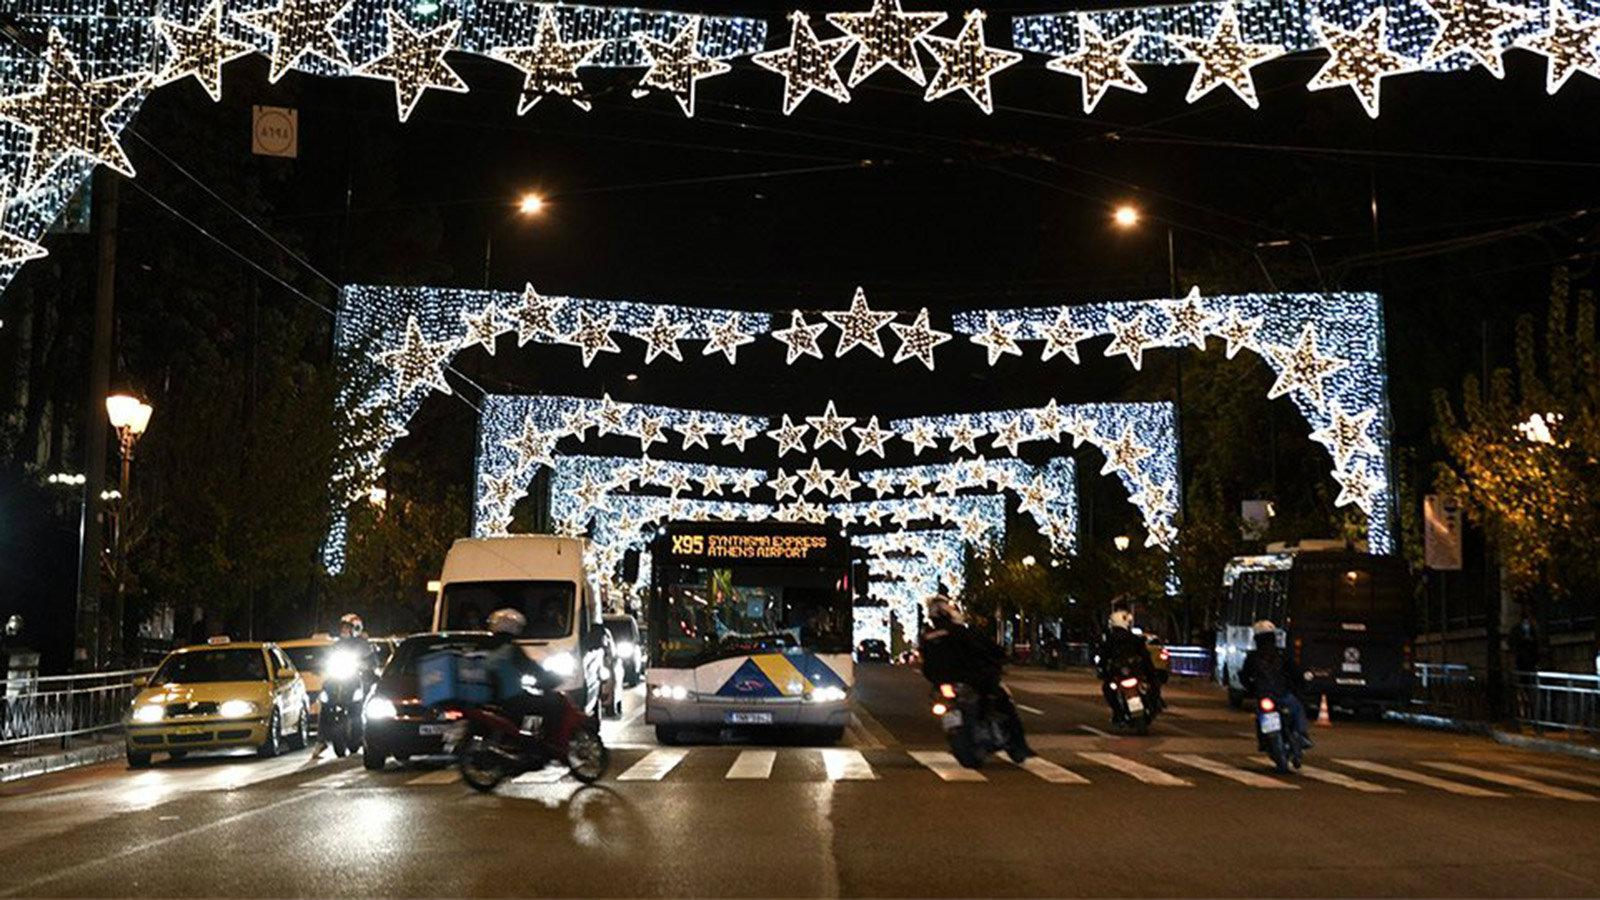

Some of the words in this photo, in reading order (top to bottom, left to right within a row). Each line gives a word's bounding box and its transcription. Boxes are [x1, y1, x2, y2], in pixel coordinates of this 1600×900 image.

[672, 535, 704, 555] X95
[708, 535, 770, 546] SYNTAGMA
[772, 536, 827, 548] EXPRESS
[708, 546, 754, 557] ATHENS
[757, 546, 808, 558] AIRPORT
